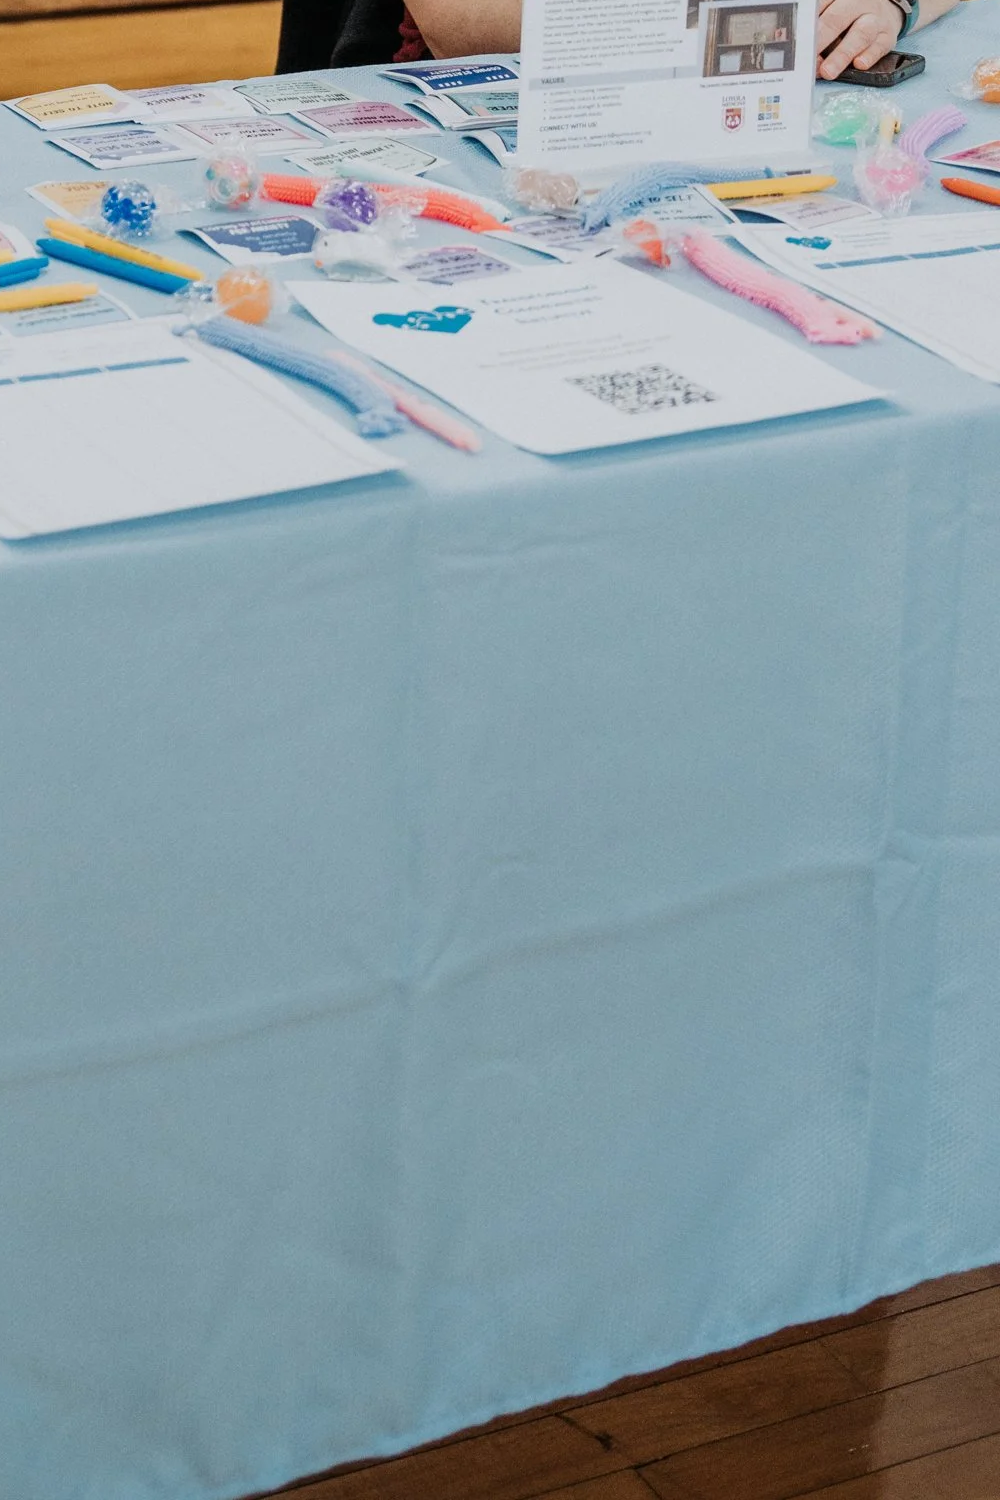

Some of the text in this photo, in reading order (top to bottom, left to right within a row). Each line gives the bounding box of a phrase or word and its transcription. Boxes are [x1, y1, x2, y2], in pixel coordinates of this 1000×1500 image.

[421, 66, 502, 81] COPING STATEMENTS
[541, 77, 565, 85] VALUES
[86, 101, 113, 109] NOTE
[539, 124, 569, 132] CONNECT
[135, 139, 161, 148] NOTE
